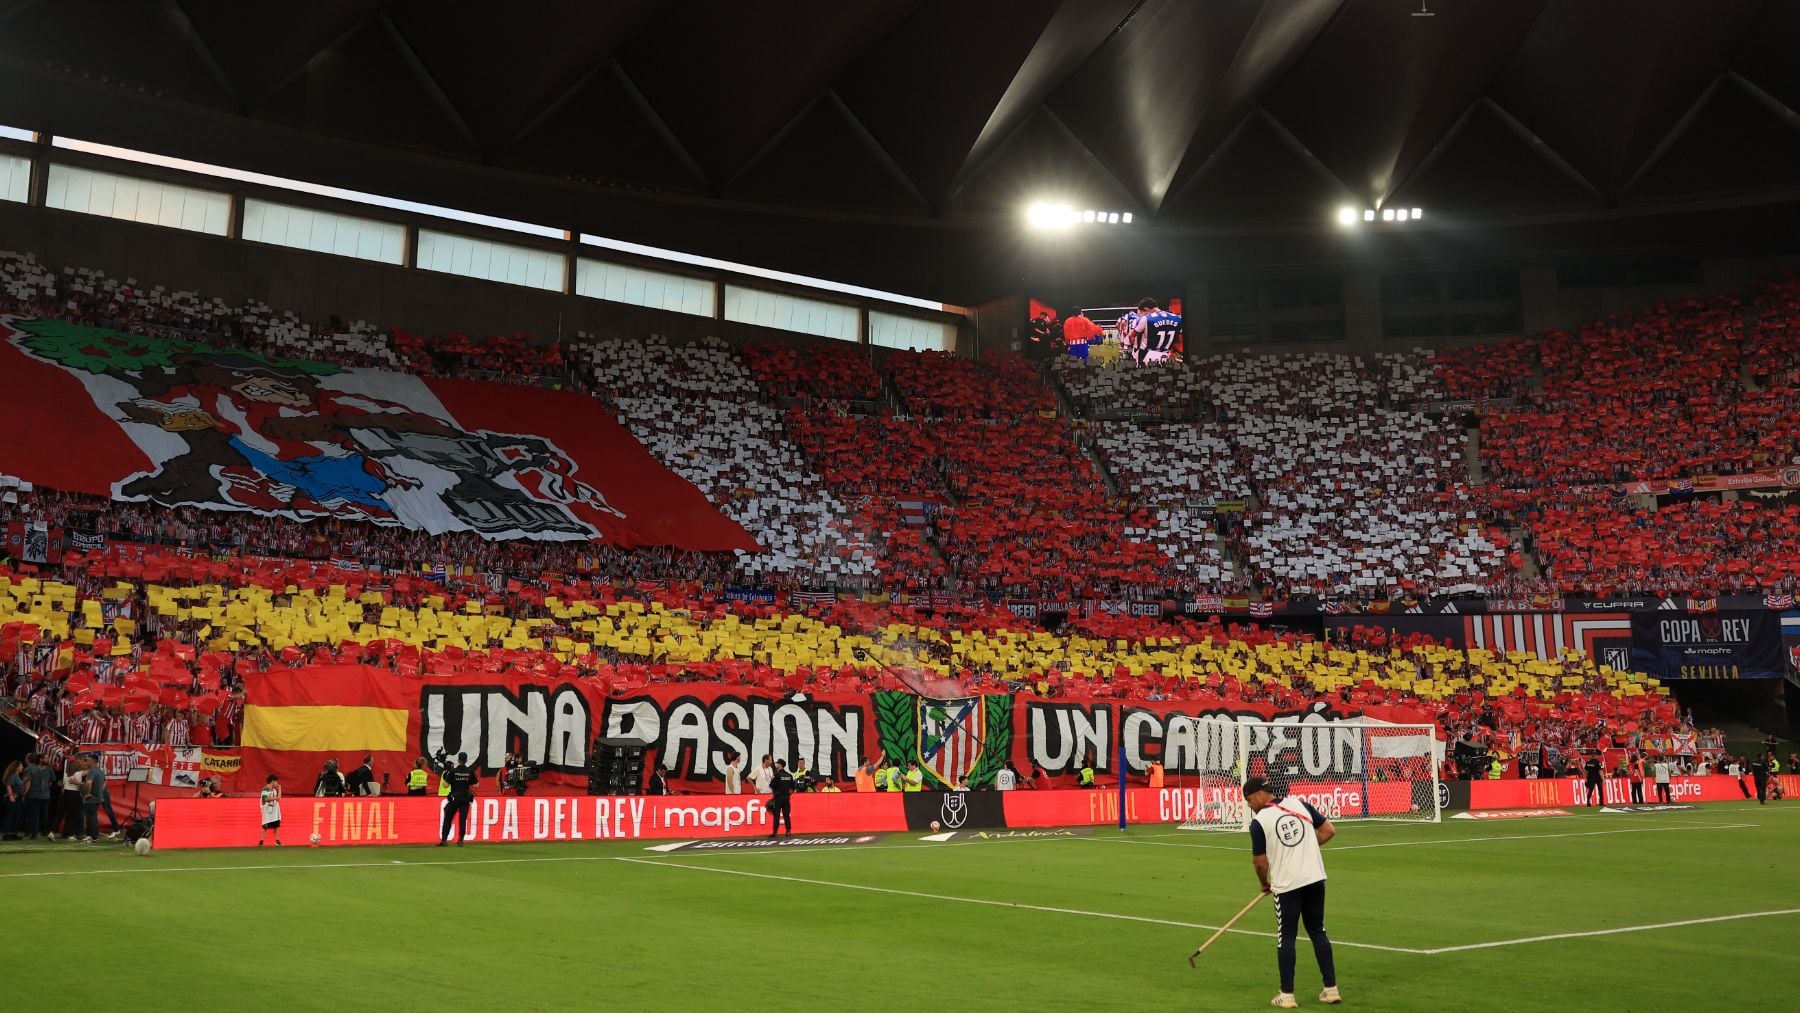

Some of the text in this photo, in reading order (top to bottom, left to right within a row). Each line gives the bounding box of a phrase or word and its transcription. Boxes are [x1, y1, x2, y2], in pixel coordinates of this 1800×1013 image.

[1156, 330, 1176, 350] 11
[1593, 601, 1644, 609] CUPRA
[1660, 619, 1701, 643] COPA
[1721, 618, 1750, 642] REY
[1697, 647, 1732, 655] mapfre
[1681, 665, 1739, 679] SEVILLA
[427, 690, 859, 778] UNA PASIÓN
[1032, 702, 1364, 777] UN CAMPEÓN
[1529, 781, 1561, 805] FINAL
[1605, 778, 1626, 804] DEL
[312, 802, 399, 841] FINAL
[534, 799, 583, 839] DEL
[596, 797, 645, 838] REY
[664, 798, 787, 832] mapfr
[1281, 820, 1296, 832] RF
[779, 837, 850, 846] Galicia
[1284, 829, 1299, 841] EF
